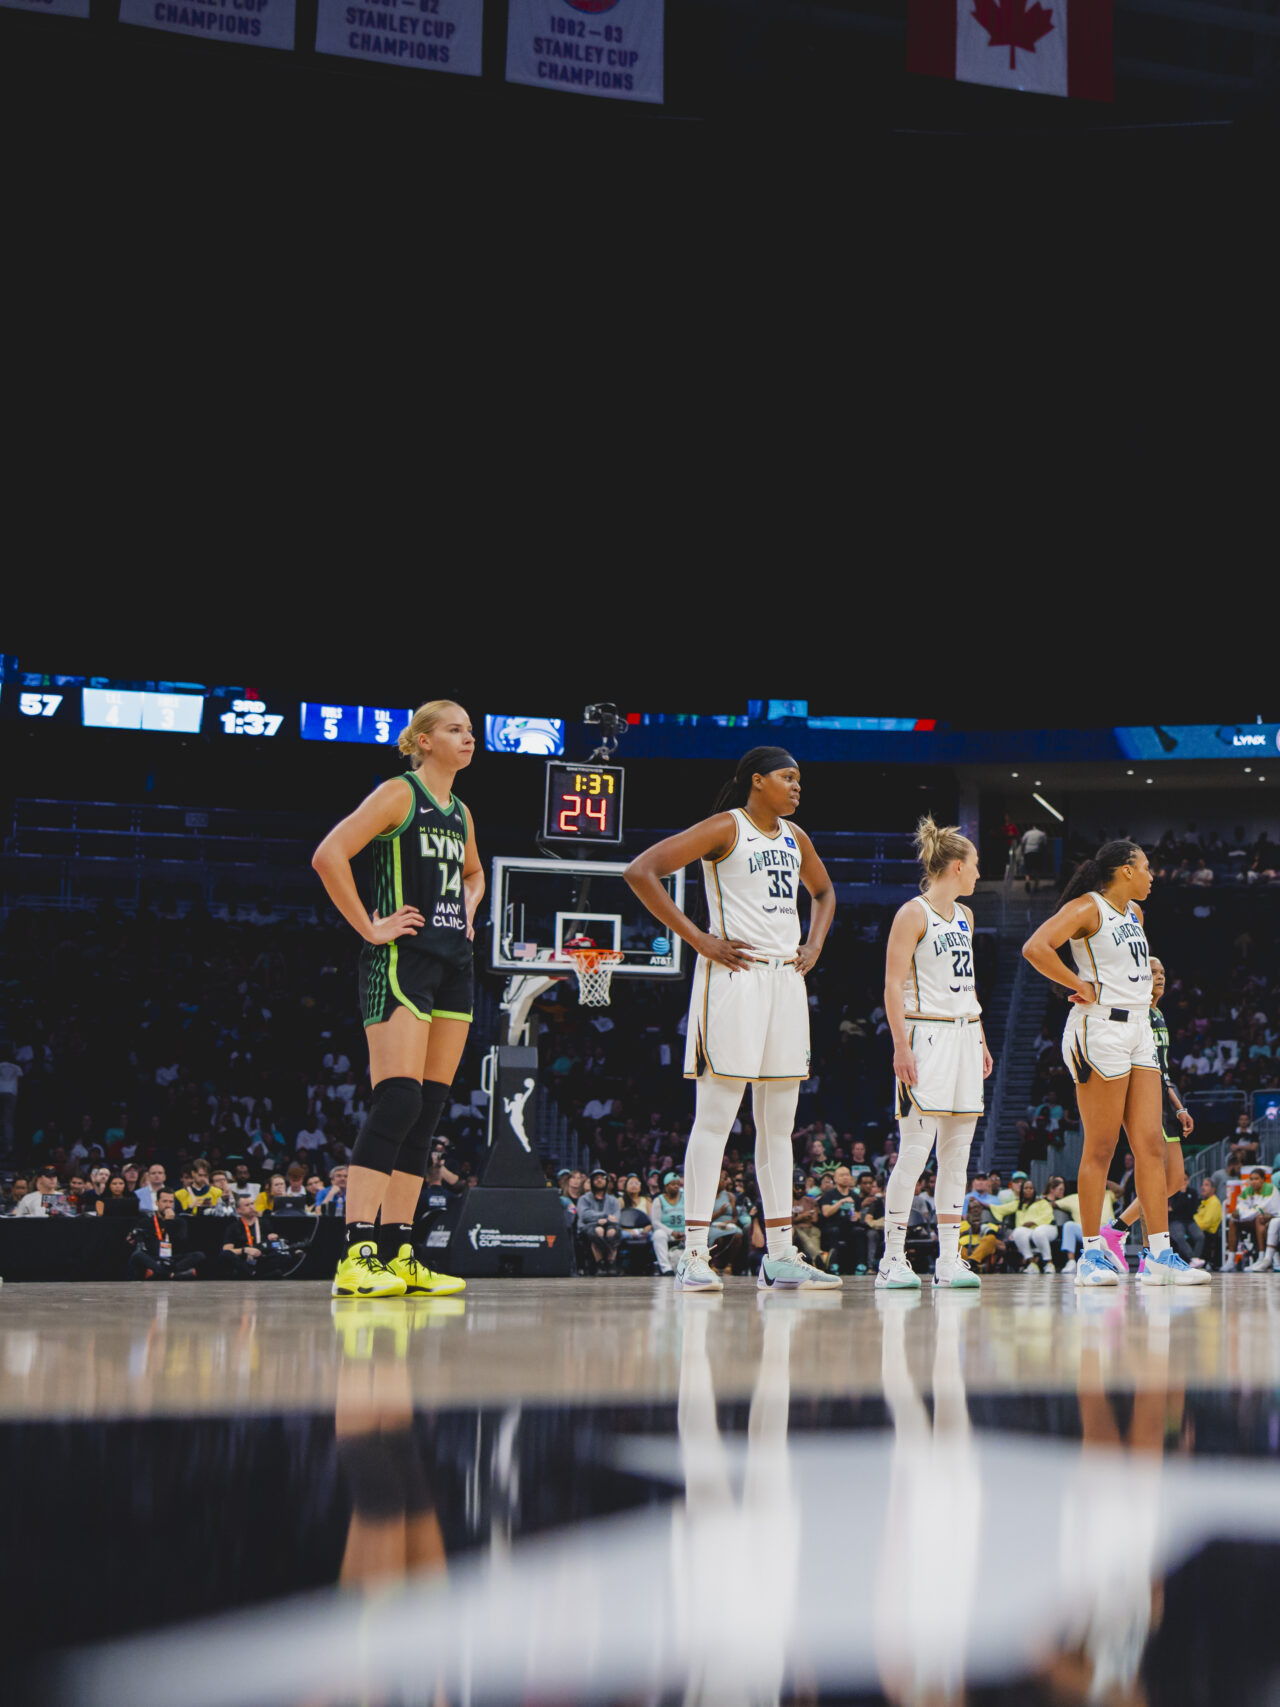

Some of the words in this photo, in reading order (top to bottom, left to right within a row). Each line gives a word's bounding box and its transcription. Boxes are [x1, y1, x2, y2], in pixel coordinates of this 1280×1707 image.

[155, 3, 262, 36] CHAMPIONS
[346, 7, 419, 34] STANLEY
[423, 20, 455, 39] CUP
[551, 16, 585, 37] 1982
[350, 32, 450, 63] CHAMPIONS
[534, 37, 603, 63] STANLEY
[608, 49, 639, 68] CUP
[538, 61, 633, 90] CHAMPIONS
[20, 693, 63, 716] 57
[221, 712, 284, 736] 1:37
[324, 718, 338, 739] 5
[375, 721, 389, 742] 3
[1233, 735, 1266, 746] LYNX
[575, 773, 614, 795] 1:37
[559, 794, 607, 832] 24
[439, 863, 462, 898] 14
[768, 869, 794, 899] 35
[933, 931, 971, 956] LIBERT
[1112, 923, 1145, 947] LIBERT
[649, 956, 672, 965] AT&T
[952, 950, 973, 977] 22
